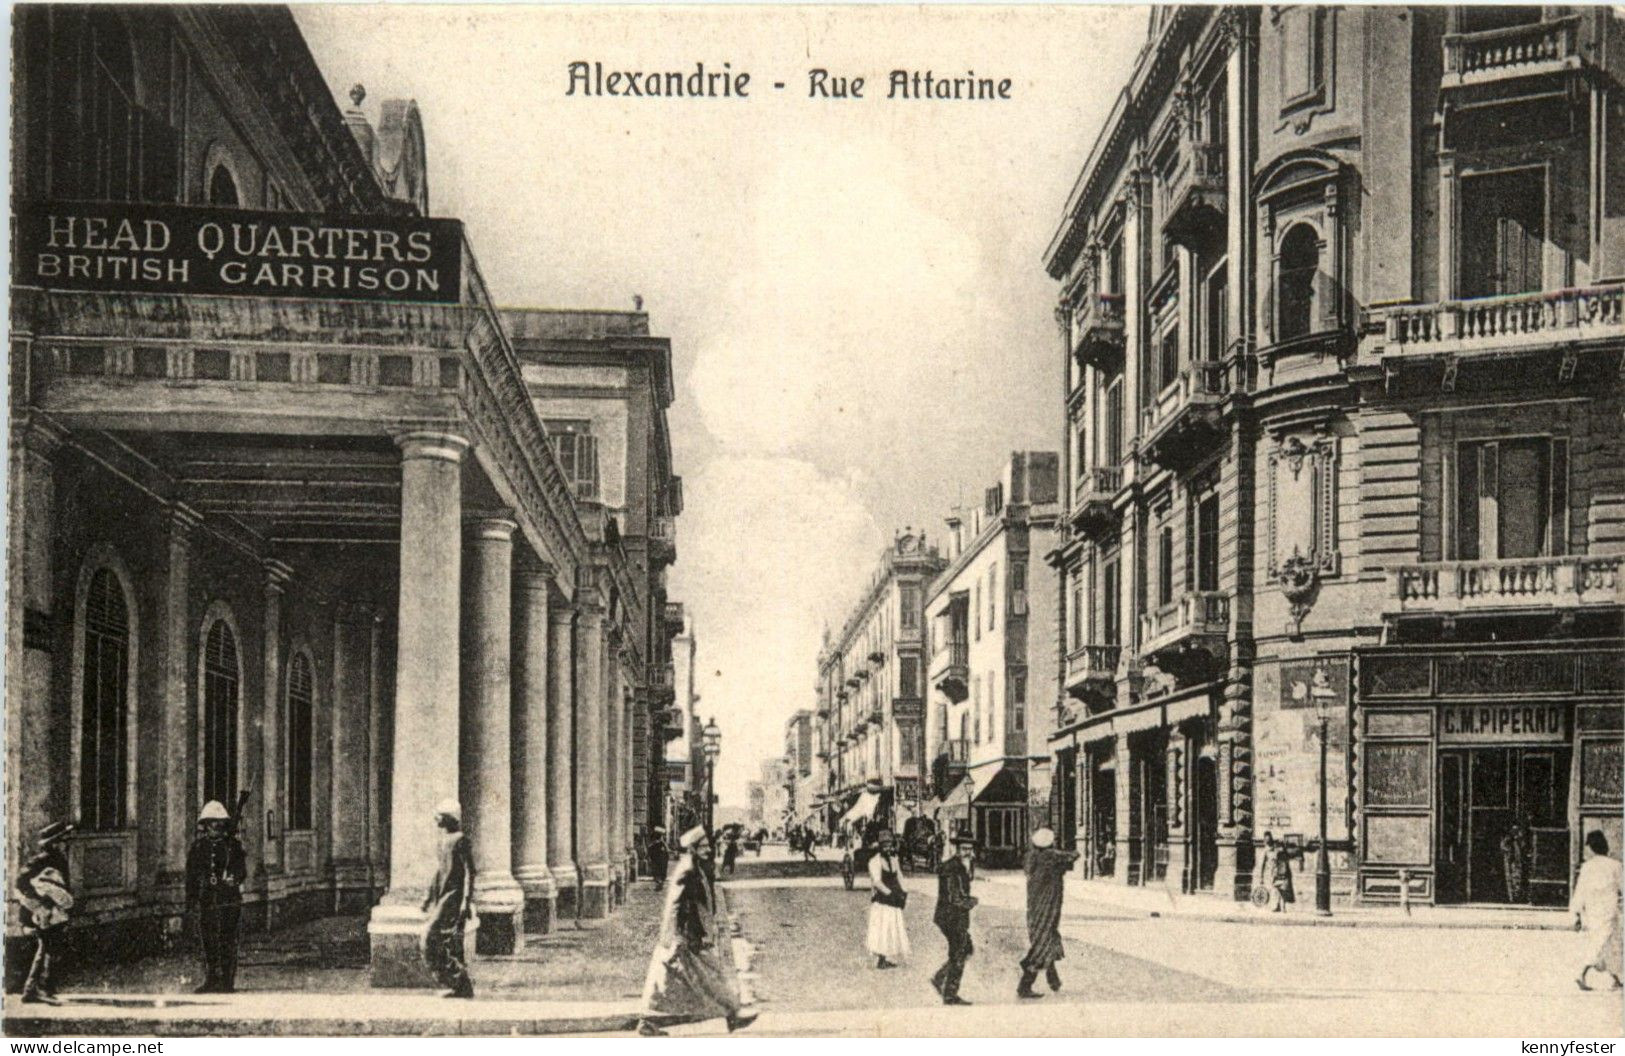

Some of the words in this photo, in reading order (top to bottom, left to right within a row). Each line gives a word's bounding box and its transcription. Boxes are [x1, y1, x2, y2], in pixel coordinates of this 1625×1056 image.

[47, 215, 171, 252] HEAD
[198, 222, 432, 262] QUARTERS
[37, 253, 189, 282] BRITISH
[220, 262, 440, 291] GARRISON
